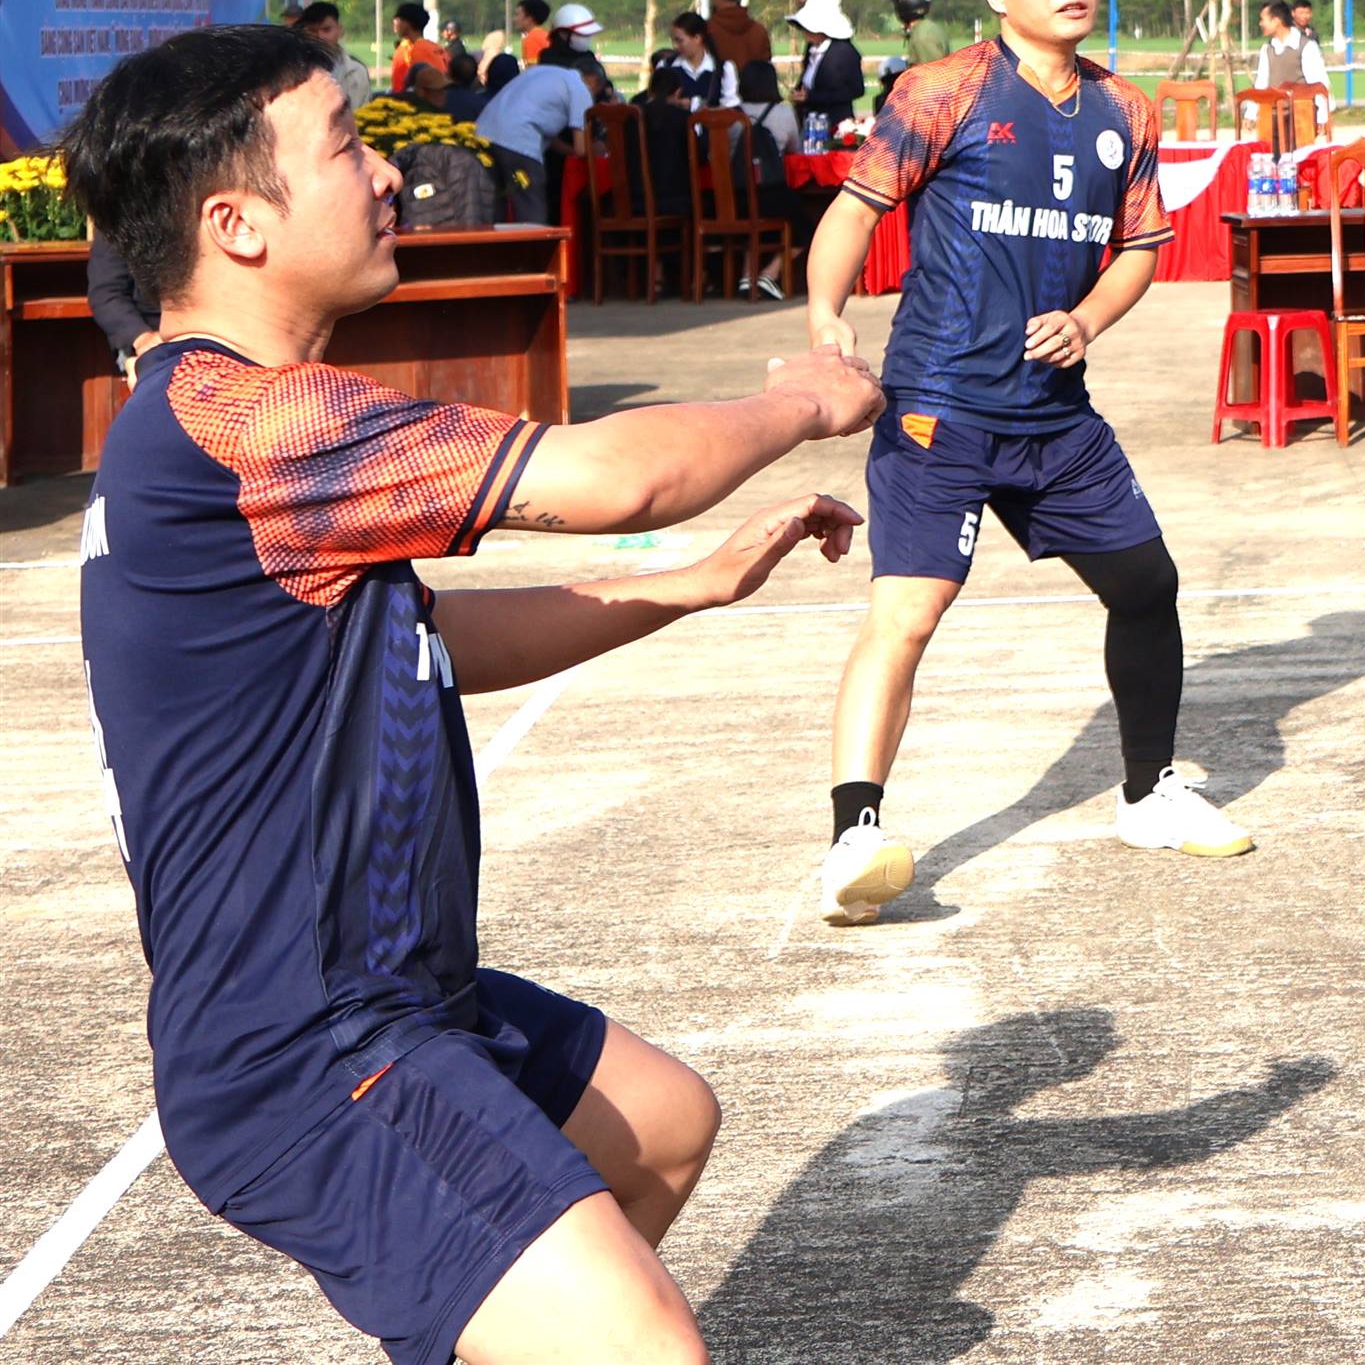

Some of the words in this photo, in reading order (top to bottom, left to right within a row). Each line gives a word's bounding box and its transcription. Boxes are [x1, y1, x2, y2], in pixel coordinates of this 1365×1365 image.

[1052, 154, 1075, 201] 5
[971, 199, 1032, 237] THÂN
[1032, 208, 1069, 240] HOA
[957, 511, 979, 557] 5
